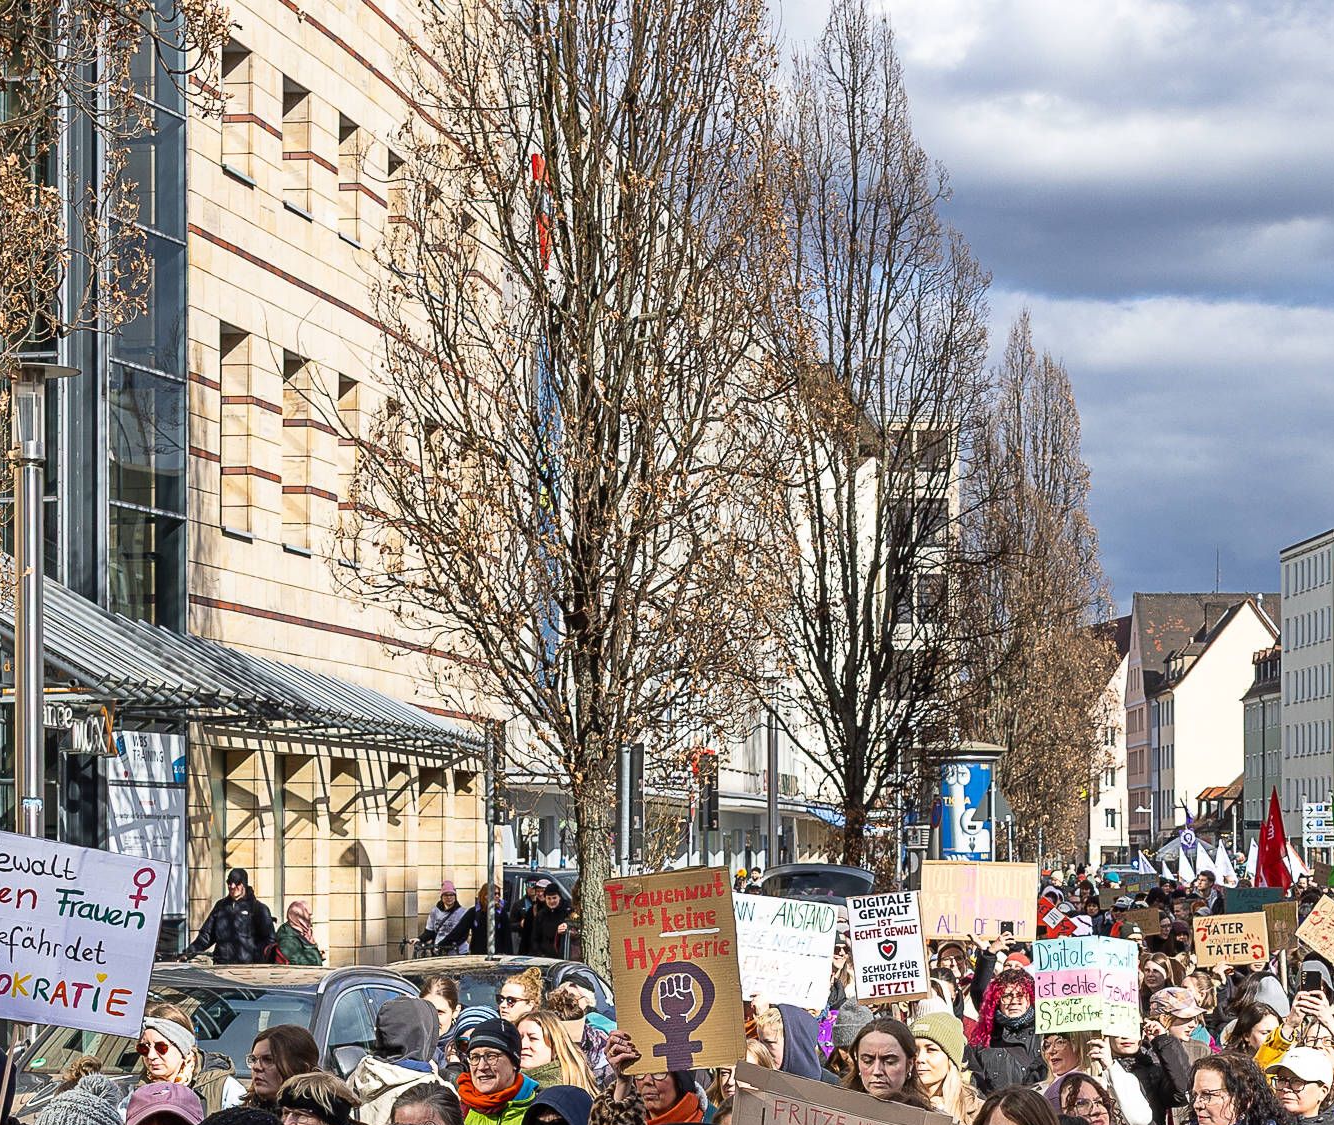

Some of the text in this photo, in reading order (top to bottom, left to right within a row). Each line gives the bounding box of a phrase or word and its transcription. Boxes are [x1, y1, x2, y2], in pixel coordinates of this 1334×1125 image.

[604, 872, 726, 912] Frauenwut
[853, 893, 913, 910] DIGITALE
[56, 888, 146, 930] Frauen
[771, 901, 837, 934] ANSTAND
[859, 905, 910, 921] GEWALT
[632, 906, 717, 933] ist keine
[877, 919, 892, 928] IST
[854, 924, 919, 941] ECHTE GEWALT
[623, 935, 731, 977] Hysterie
[1035, 939, 1097, 971] Digitale
[862, 960, 919, 974] SCHUTZ FÜR
[862, 970, 921, 983] BETROFFENE
[869, 981, 916, 998] JETZT!
[1037, 975, 1057, 997] ist
[1062, 974, 1099, 996] echte
